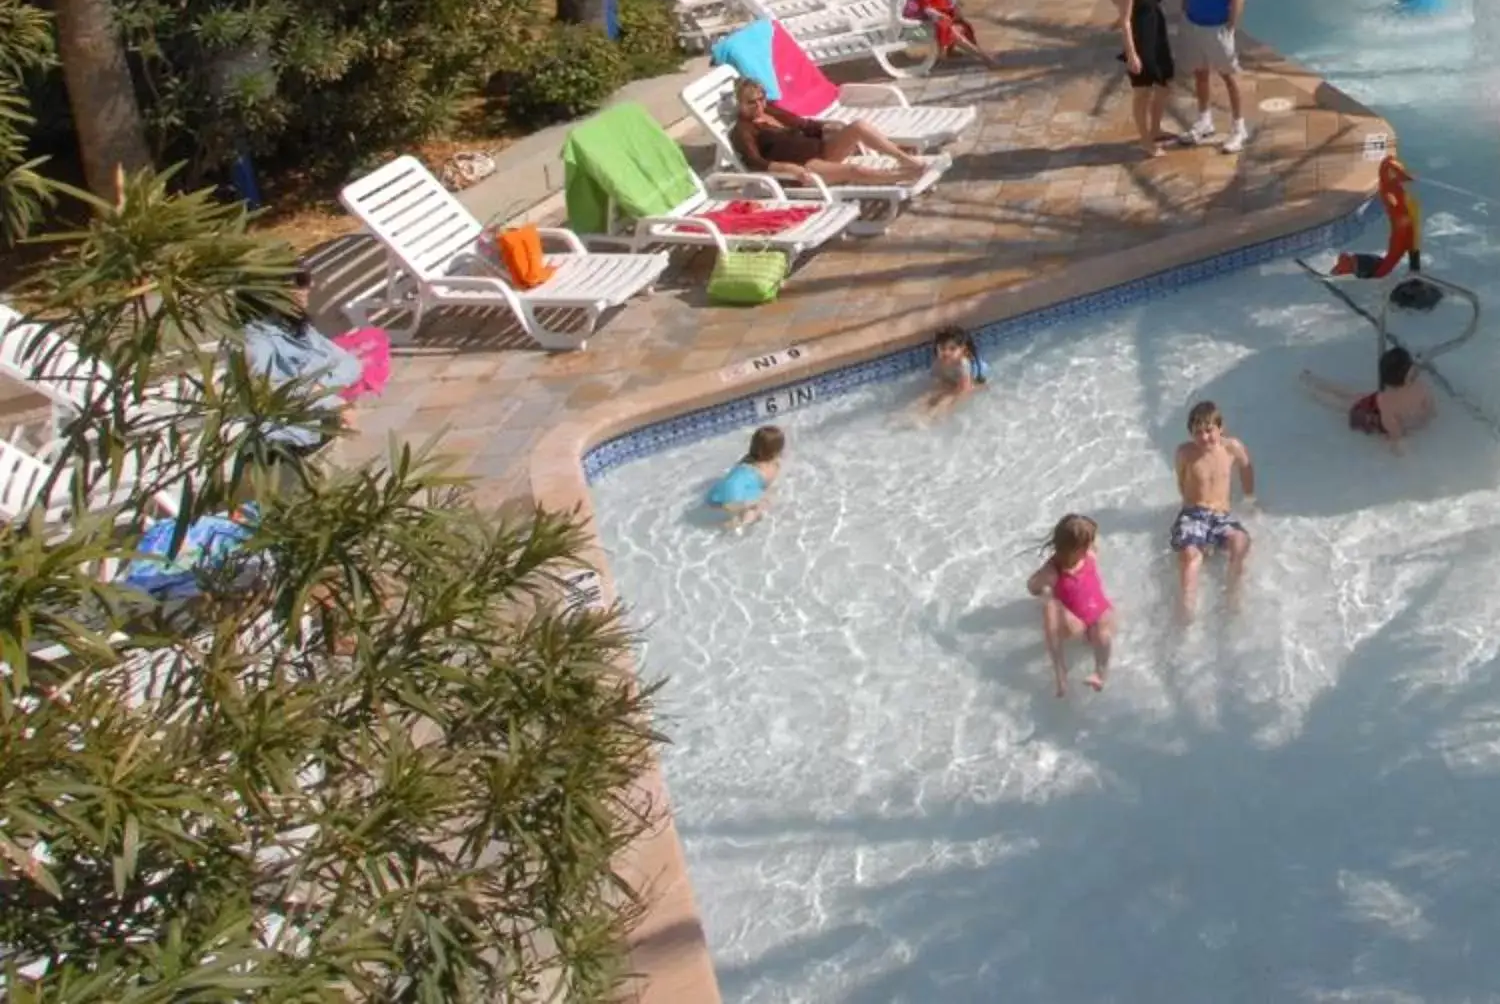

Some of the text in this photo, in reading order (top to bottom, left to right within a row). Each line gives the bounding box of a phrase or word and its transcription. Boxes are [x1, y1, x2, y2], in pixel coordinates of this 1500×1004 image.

[752, 354, 778, 370] IN
[765, 385, 814, 413] 6 IN
